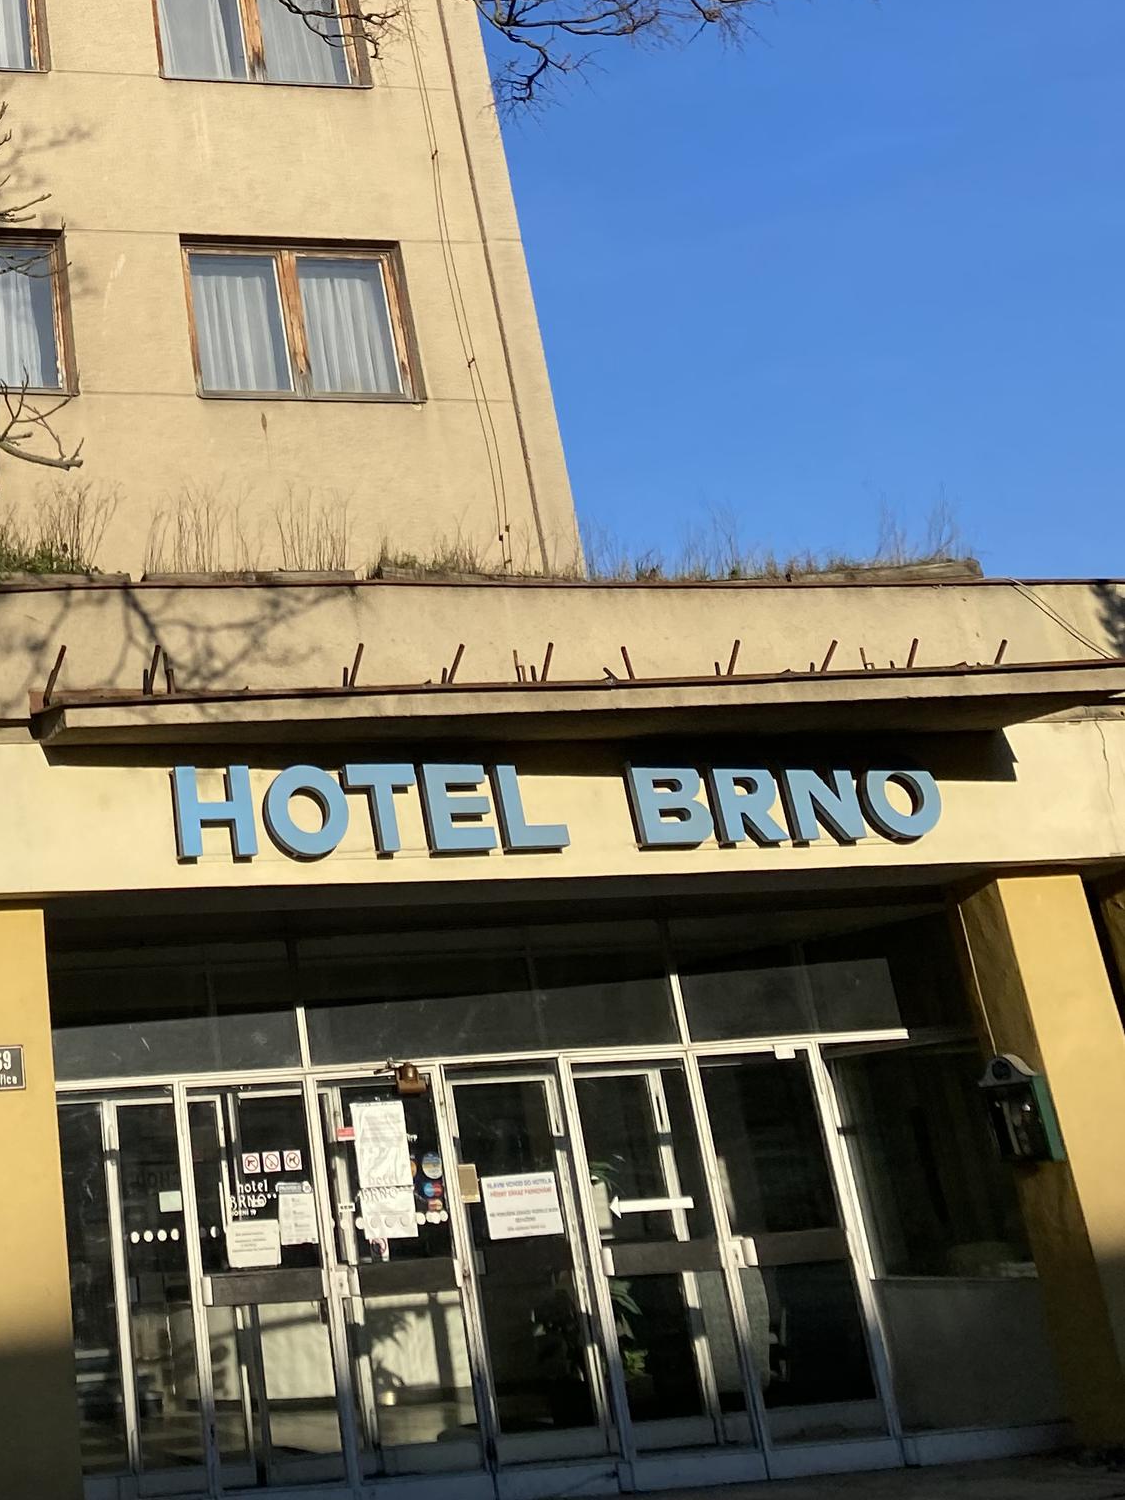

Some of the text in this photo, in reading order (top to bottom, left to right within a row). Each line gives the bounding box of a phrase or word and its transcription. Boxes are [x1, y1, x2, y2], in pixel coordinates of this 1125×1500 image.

[172, 763, 943, 862] HOTEL BRNO
[237, 1178, 268, 1193] hotel
[229, 1194, 267, 1210] BRNO
